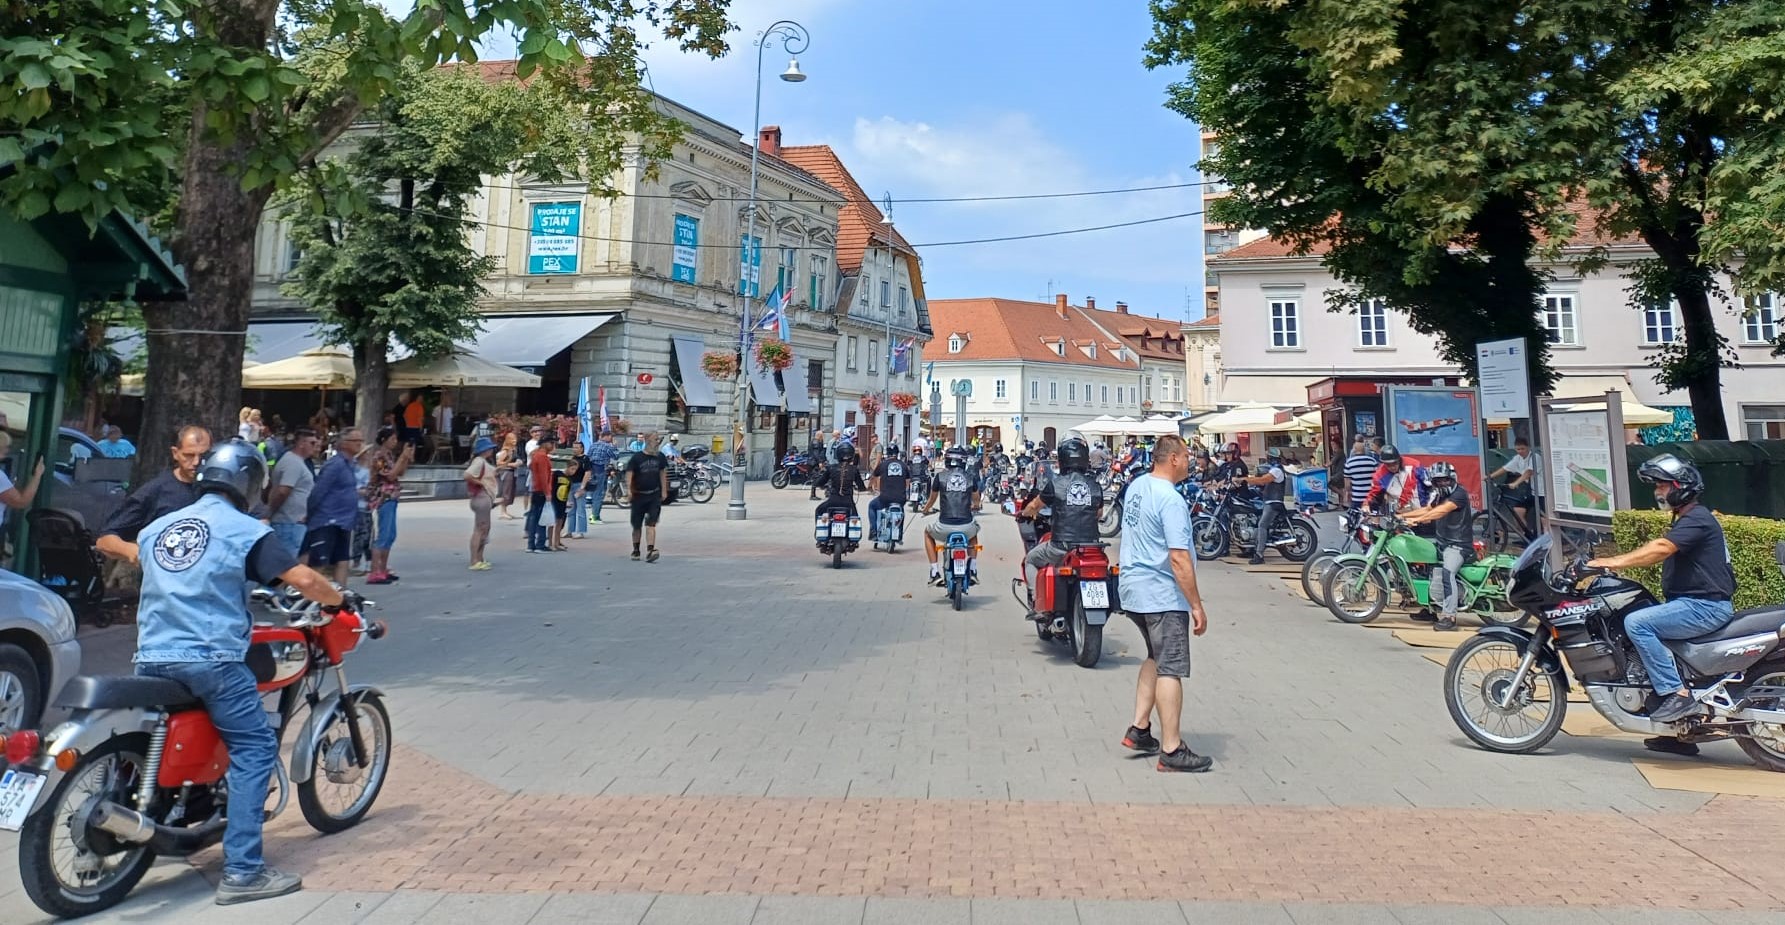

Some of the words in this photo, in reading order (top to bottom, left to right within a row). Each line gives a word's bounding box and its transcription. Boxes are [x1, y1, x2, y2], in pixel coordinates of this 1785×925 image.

[541, 216, 570, 227] STAN
[543, 257, 560, 266] PEX
[1545, 602, 1605, 618] TRANSALP
